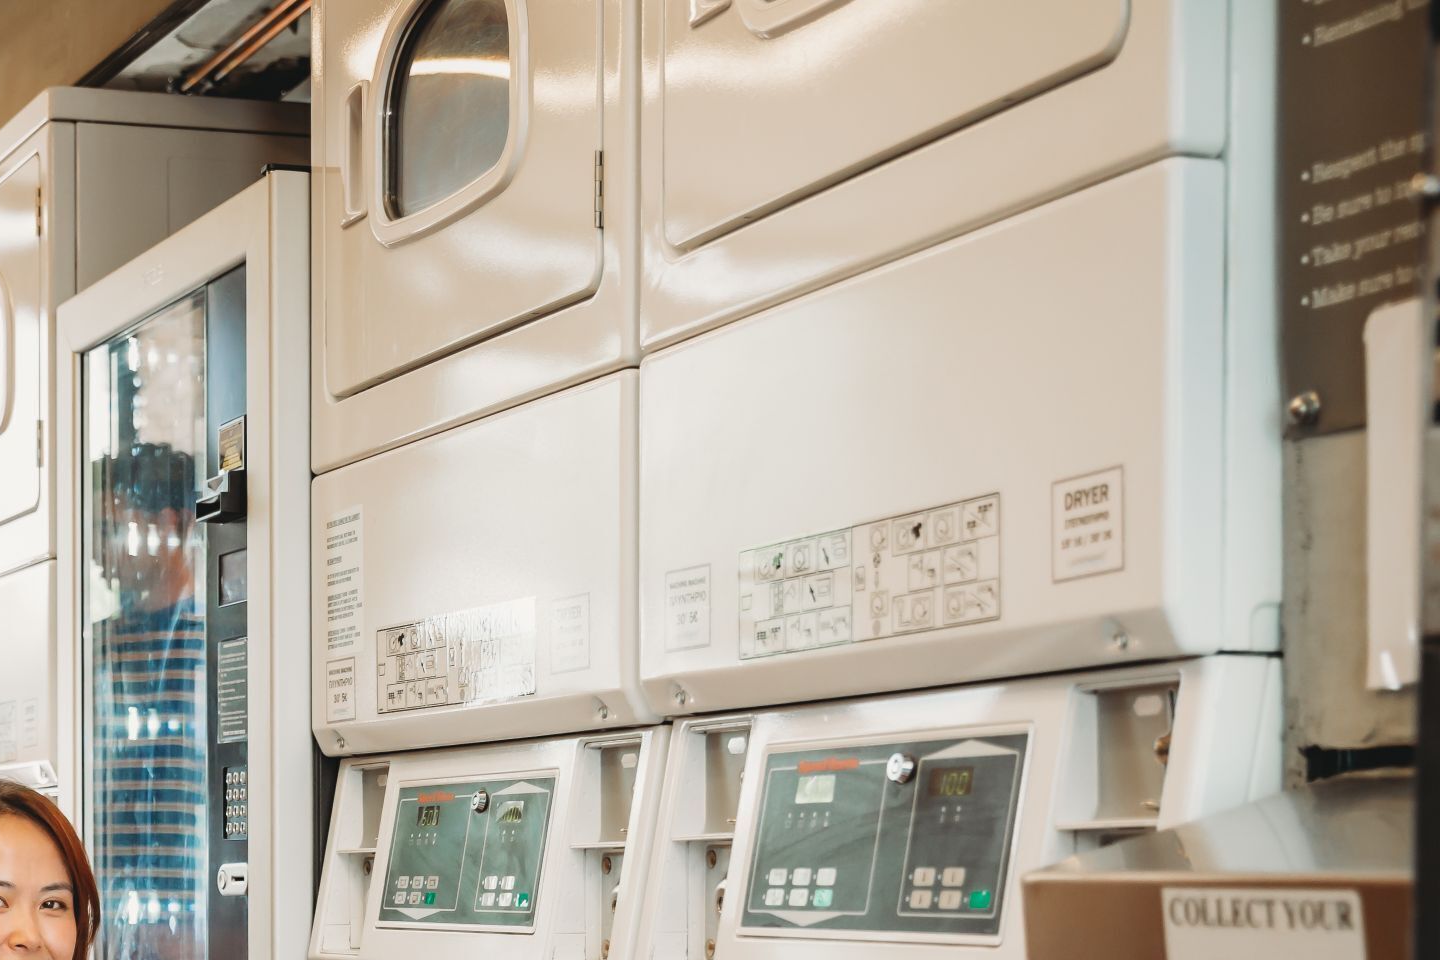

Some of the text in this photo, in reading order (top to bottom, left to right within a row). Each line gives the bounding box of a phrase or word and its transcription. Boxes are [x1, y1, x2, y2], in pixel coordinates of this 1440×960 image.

[1064, 483, 1109, 511] DRYER
[940, 771, 969, 796] 100
[1168, 898, 1355, 931] COLLECT YOUR
